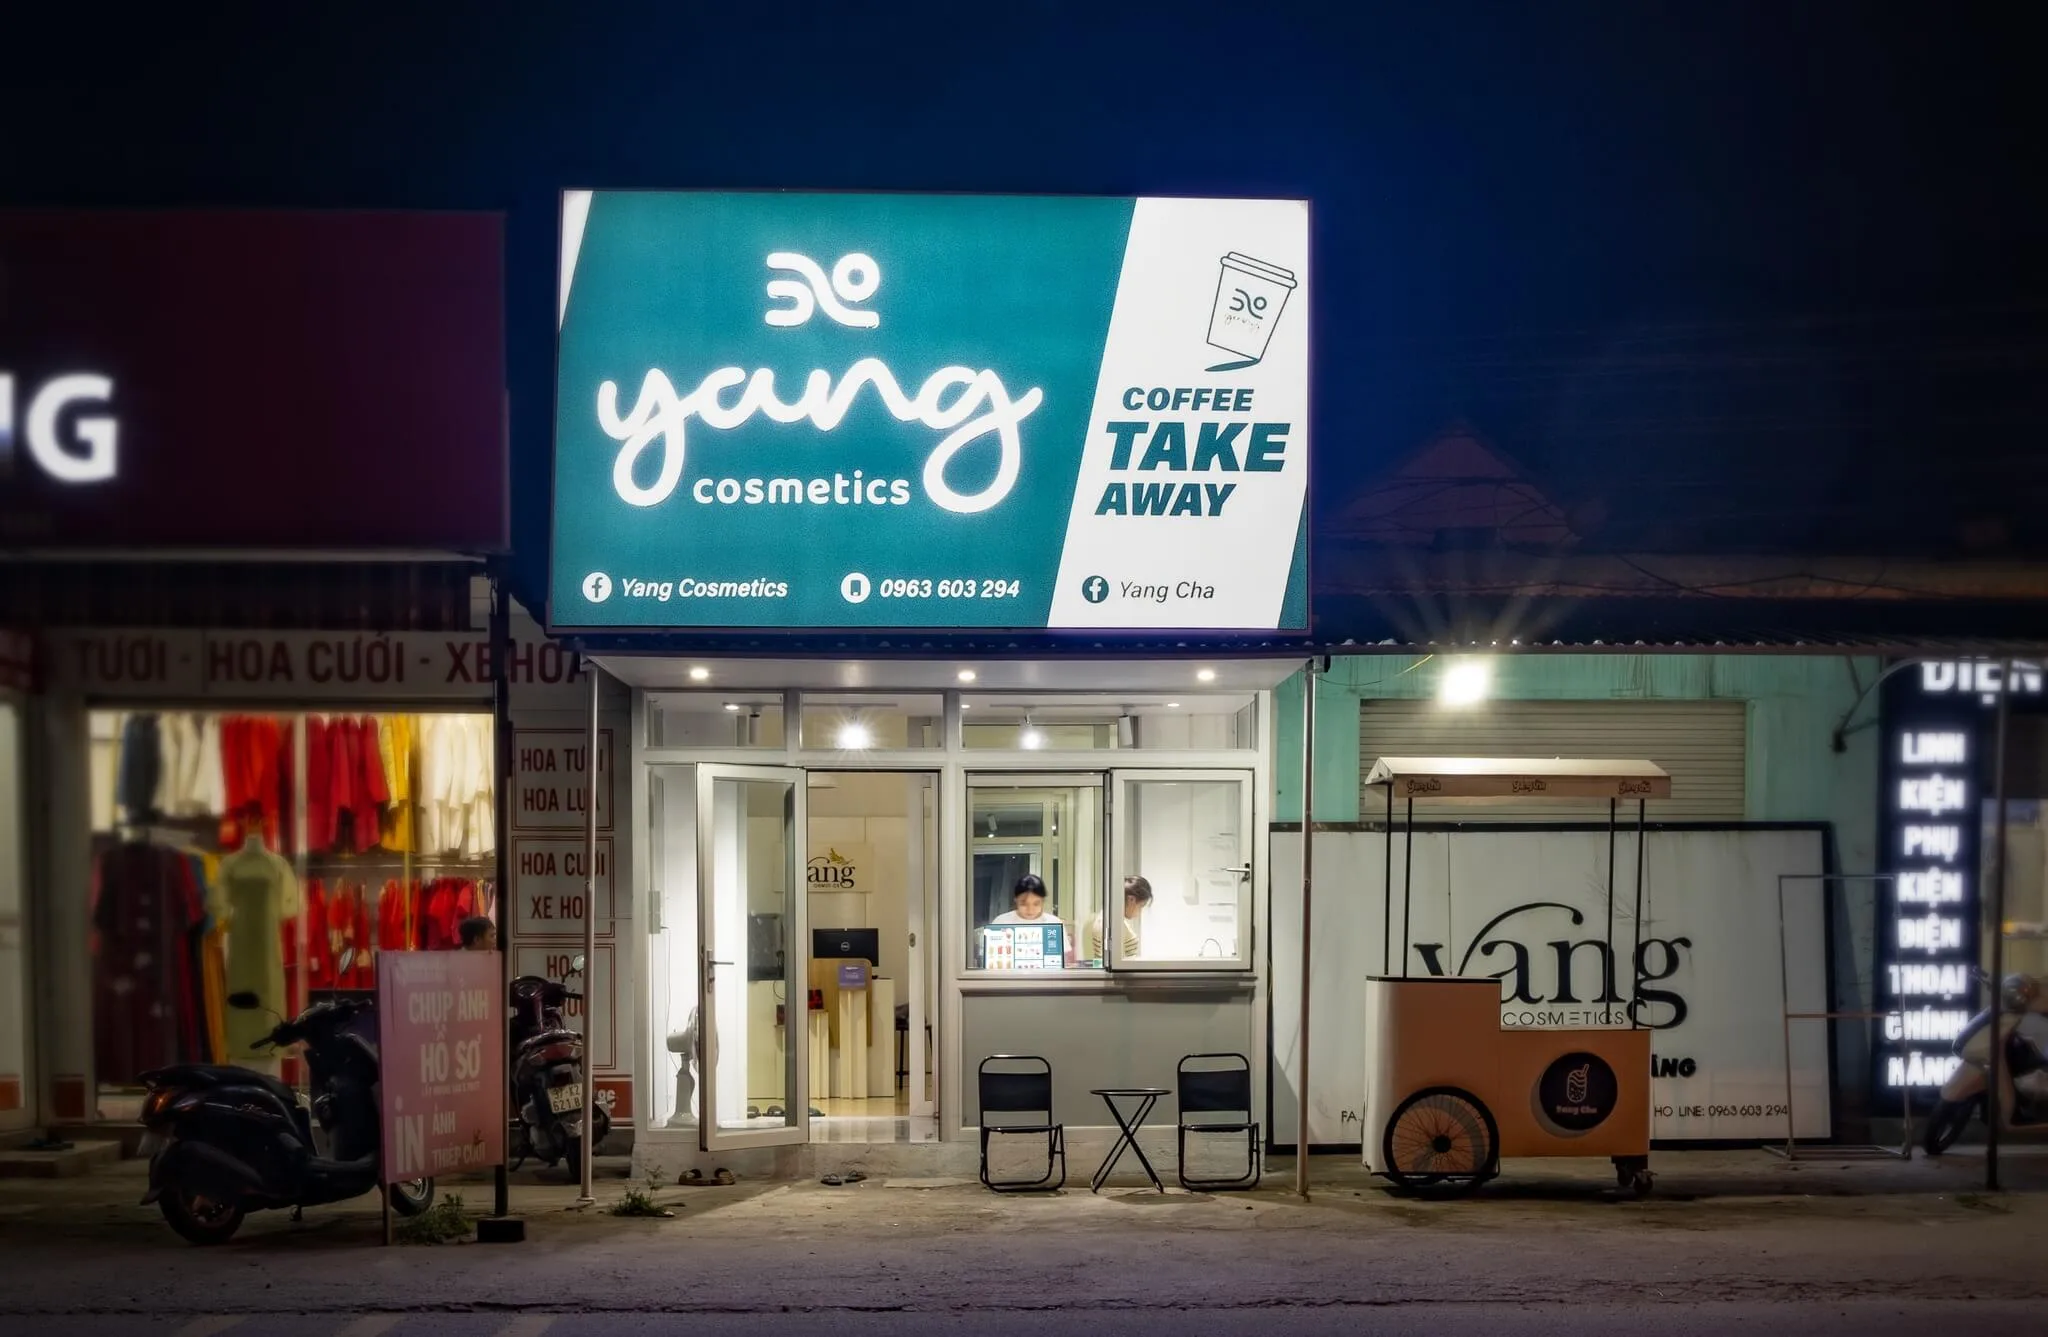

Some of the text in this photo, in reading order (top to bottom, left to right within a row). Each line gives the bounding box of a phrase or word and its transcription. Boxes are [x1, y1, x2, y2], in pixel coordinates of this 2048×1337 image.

[1123, 386, 1255, 412] COFFEE
[597, 356, 1043, 515] yang
[1105, 422, 1291, 473] TAKE
[692, 470, 911, 506] cosmetics
[1094, 483, 1237, 517] AWAY
[622, 577, 788, 603] Yang Cosmetics
[879, 578, 1020, 599] 0963 603 294
[1120, 580, 1215, 604] Yang Cha
[209, 639, 294, 683] HOA
[520, 743, 604, 772] HOA TƯI
[523, 788, 560, 812] HOA
[521, 852, 557, 876] HOA
[531, 895, 584, 920] XE HO
[1502, 1011, 1625, 1027] COSMETICS
[1708, 1104, 1738, 1117] 0963
[1740, 1104, 1763, 1117] 603
